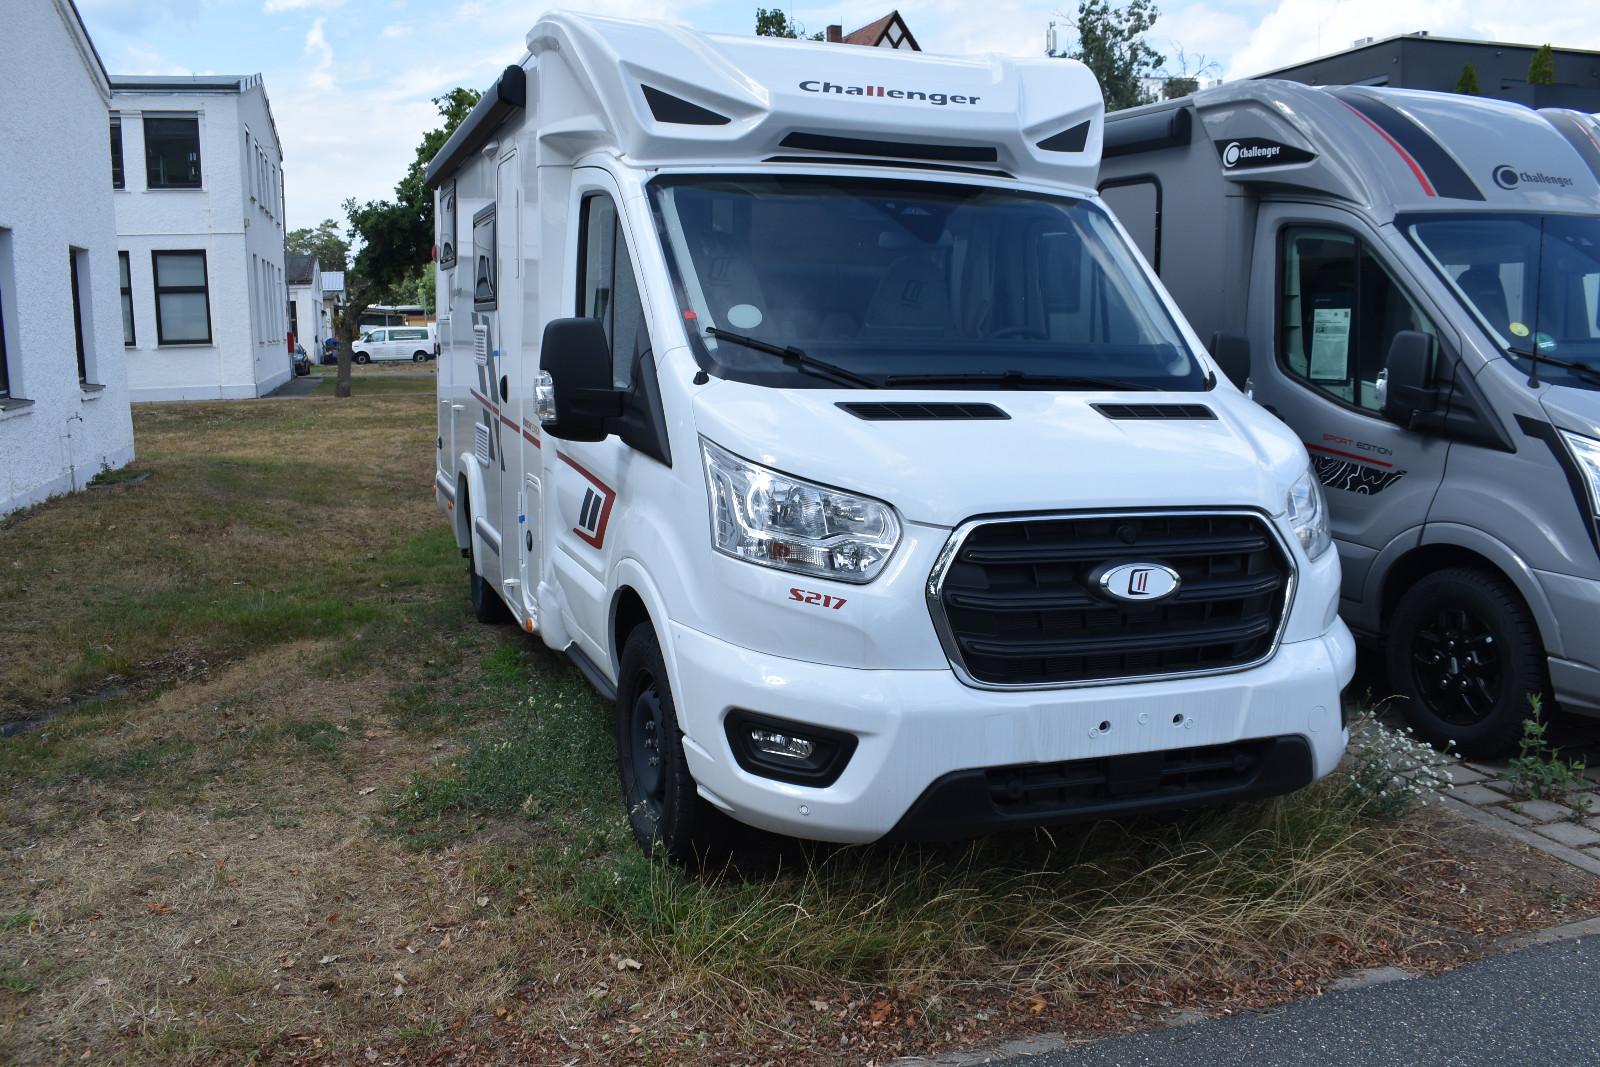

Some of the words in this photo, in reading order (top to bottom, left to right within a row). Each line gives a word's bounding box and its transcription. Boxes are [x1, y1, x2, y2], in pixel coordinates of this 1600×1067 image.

[799, 80, 981, 106] Challenger
[1240, 146, 1281, 158] Challenger
[1520, 171, 1574, 188] Challenger
[1323, 432, 1354, 447] SPORT
[1356, 441, 1393, 456] EDITION
[788, 588, 848, 610] S217
